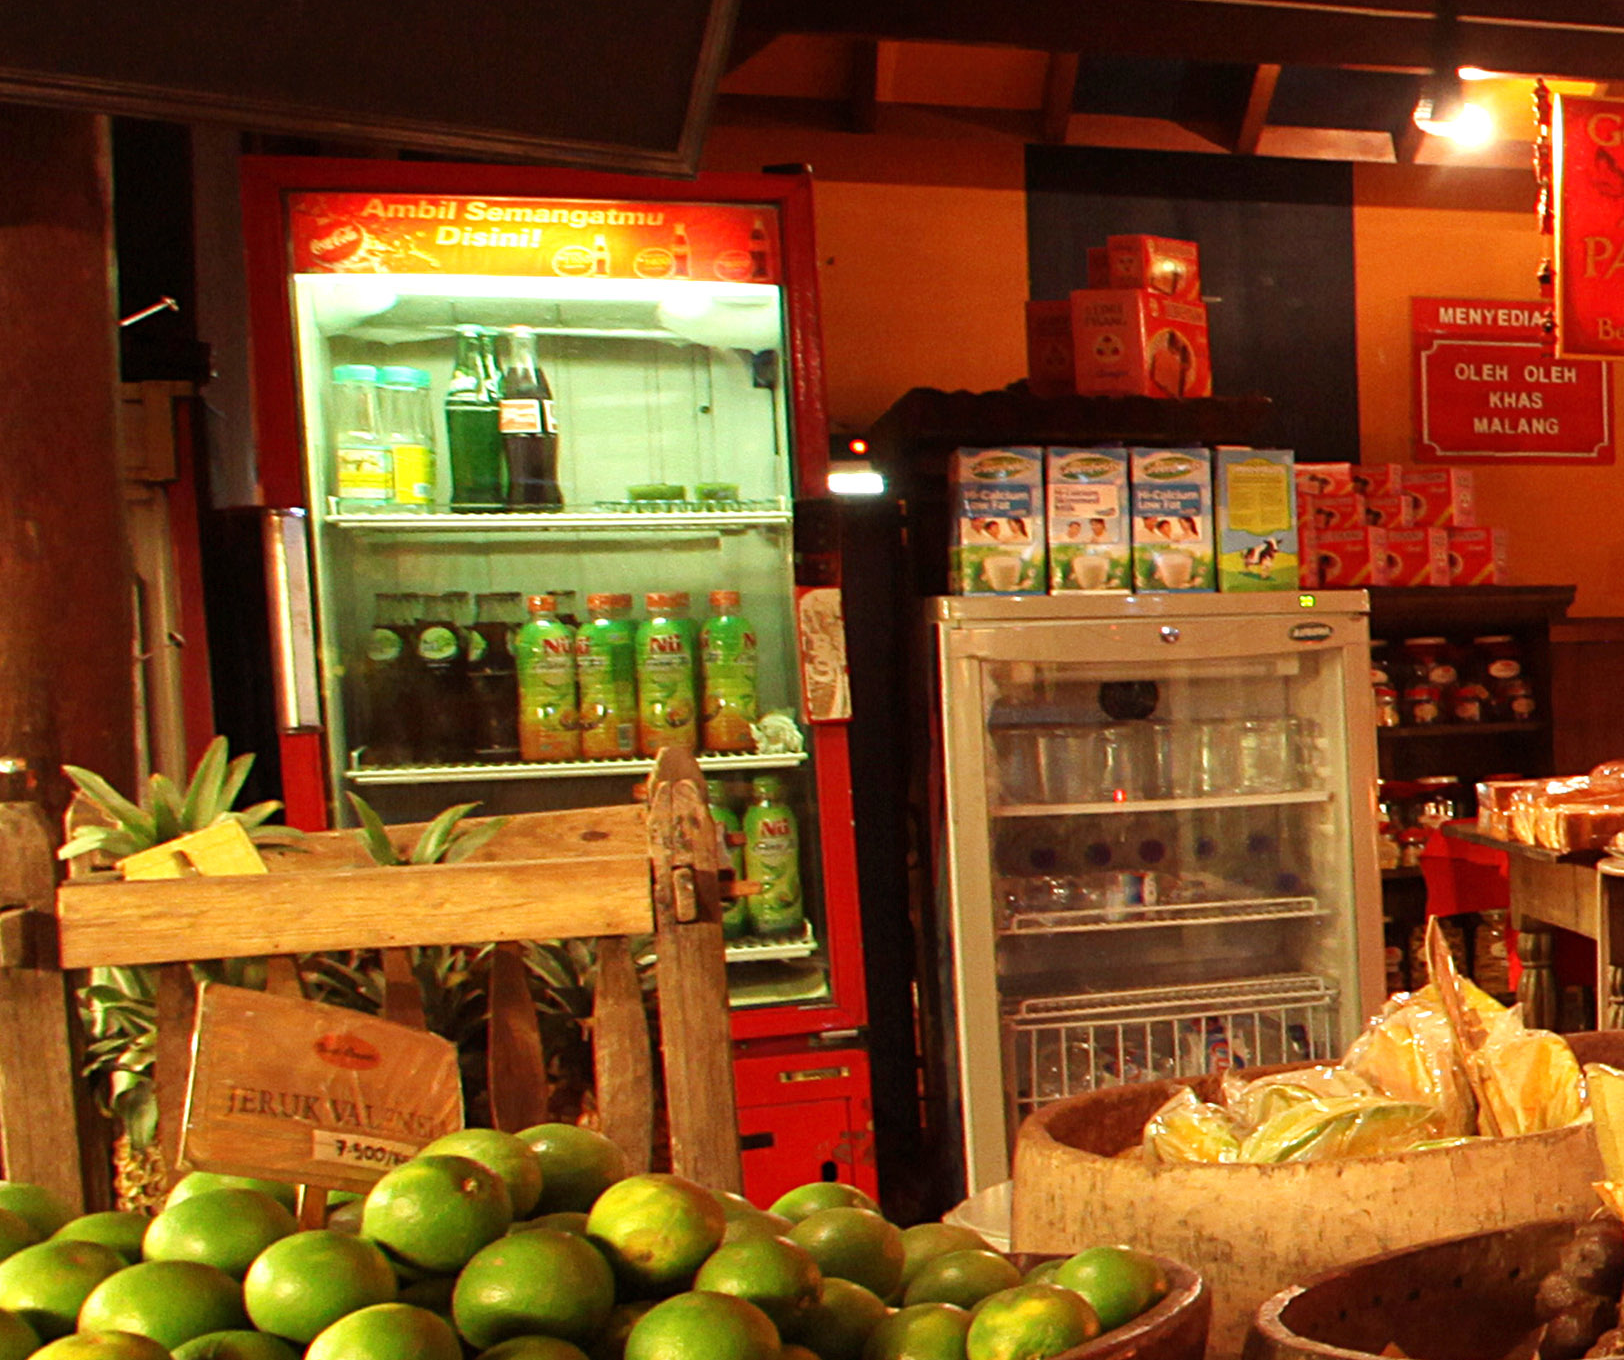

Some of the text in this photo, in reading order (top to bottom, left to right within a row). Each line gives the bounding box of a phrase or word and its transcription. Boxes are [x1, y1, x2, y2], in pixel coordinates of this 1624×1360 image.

[361, 198, 664, 227] Ambil Semangatmu
[436, 226, 541, 248] Disini!
[1439, 304, 1547, 329] MENYEDIA
[1454, 362, 1577, 386] OLEH OLEH
[1489, 390, 1544, 410] KHAS
[1473, 415, 1560, 436] MALANG
[227, 1087, 325, 1122] JERUK
